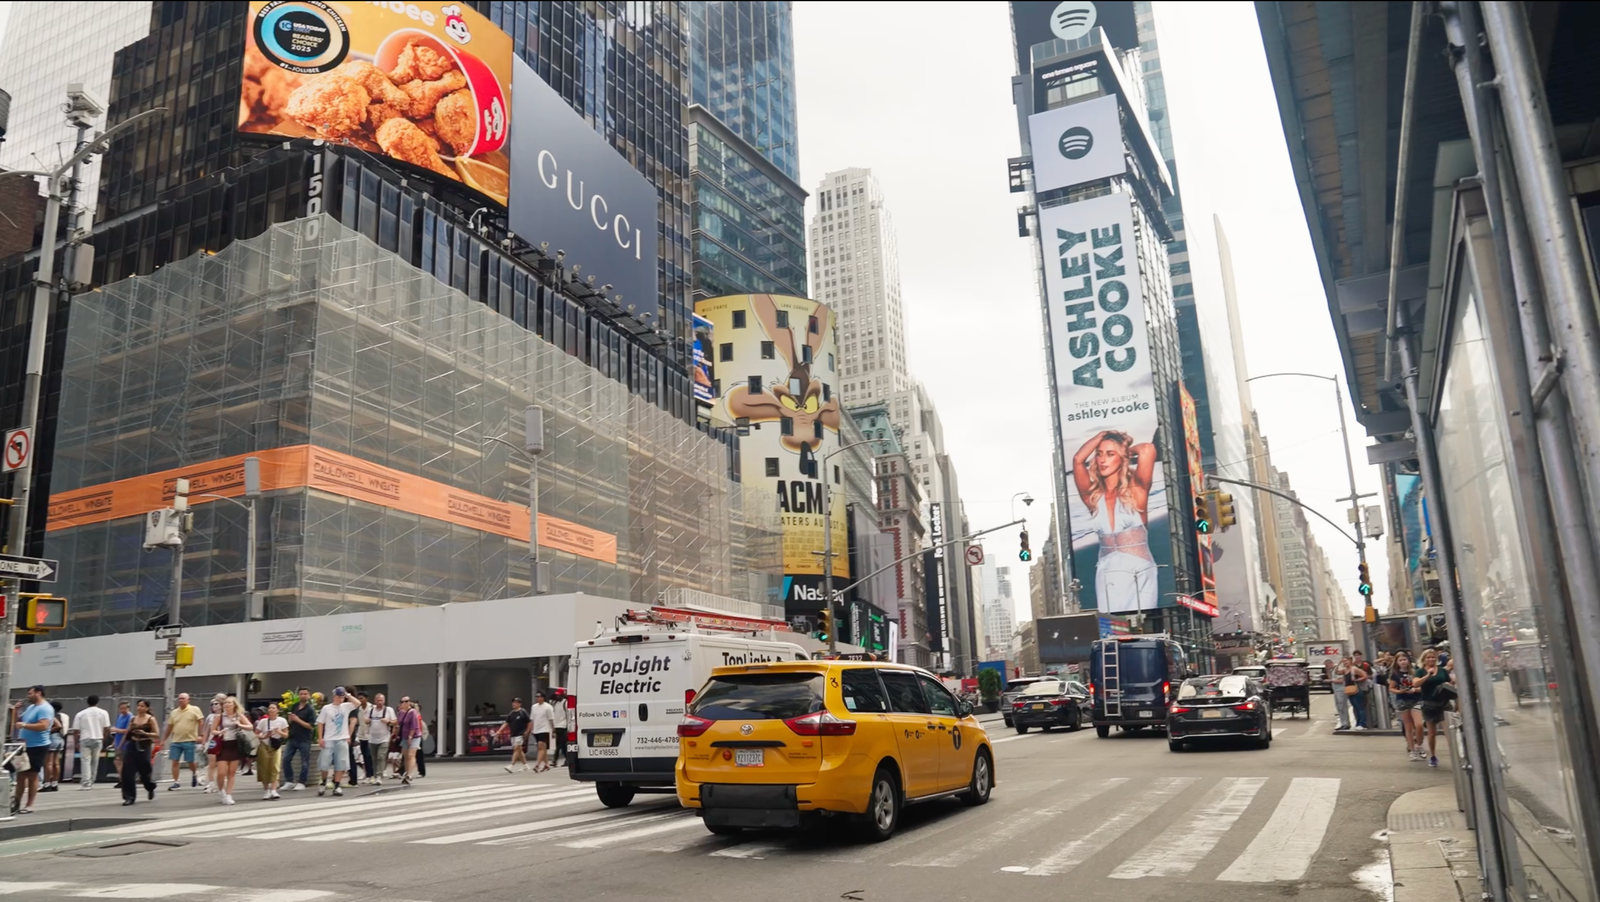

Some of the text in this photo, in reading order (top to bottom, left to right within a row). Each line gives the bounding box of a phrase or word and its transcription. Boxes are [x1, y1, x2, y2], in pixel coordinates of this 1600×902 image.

[291, 44, 311, 52] 2025
[292, 39, 318, 48] CHOICE
[1074, 60, 1097, 71] square
[305, 153, 322, 241] 1500
[538, 150, 642, 260] GUCCI
[1091, 223, 1137, 372] COOKE
[1056, 228, 1104, 389] ASHLEY
[1111, 394, 1139, 404] ALBUM
[1068, 401, 1149, 422] ashley cooke
[212, 470, 245, 484] WINGATE
[314, 462, 400, 494] CAULDWELL WINGATE
[85, 497, 112, 509] WINGATE
[776, 480, 832, 516] ACM
[448, 500, 510, 524] CAULDWELL WINGATE
[932, 505, 942, 536] Locker
[814, 518, 839, 530] AUUST
[546, 527, 574, 541] CAULDWELL
[0, 561, 48, 575] ONE WAY
[794, 584, 845, 606] Nasaq
[1309, 646, 1339, 656] FedEx
[592, 655, 671, 677] TopLight
[600, 676, 661, 695] Electric
[637, 736, 679, 744] 732-446-4789
